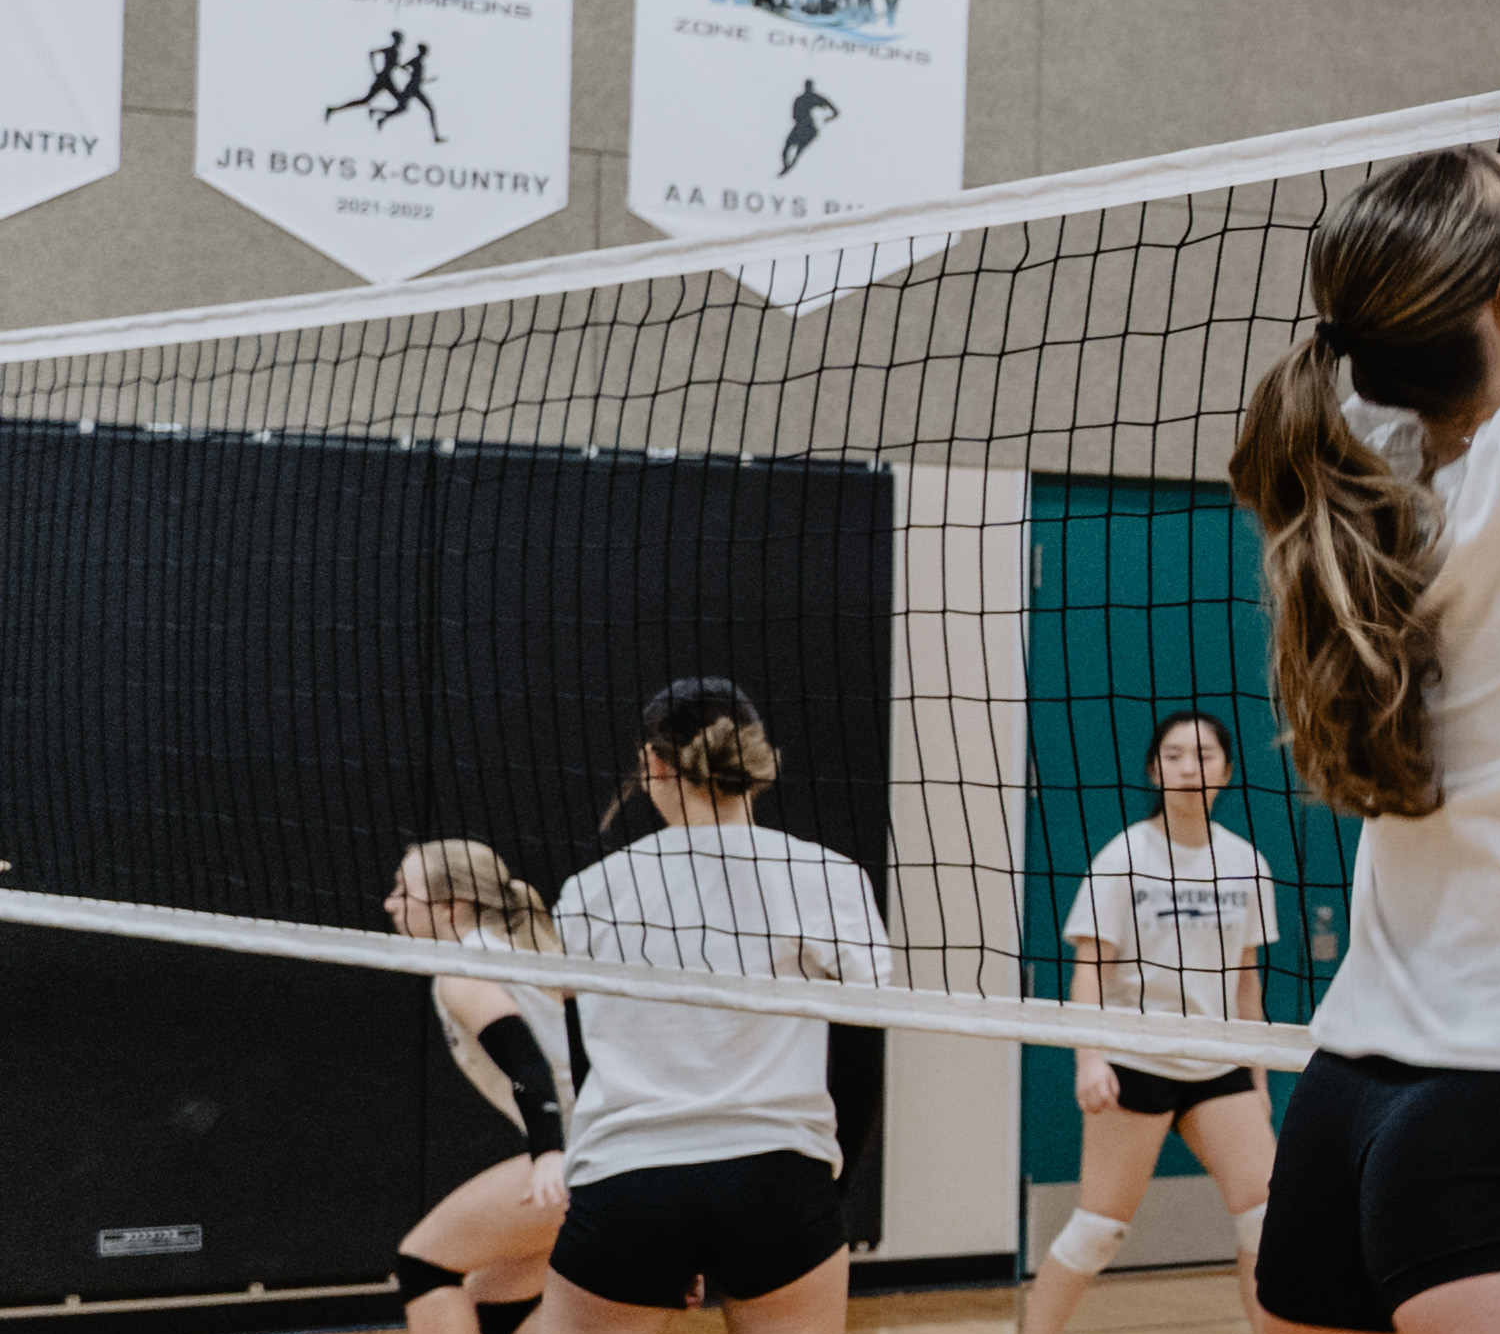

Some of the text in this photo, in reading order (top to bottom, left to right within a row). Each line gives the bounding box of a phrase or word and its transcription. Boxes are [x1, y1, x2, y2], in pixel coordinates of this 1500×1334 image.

[674, 17, 932, 65] ZONE CHAMPIONS
[216, 147, 550, 196] JR BOYS X-COUNTRY
[721, 186, 808, 219] BOYS
